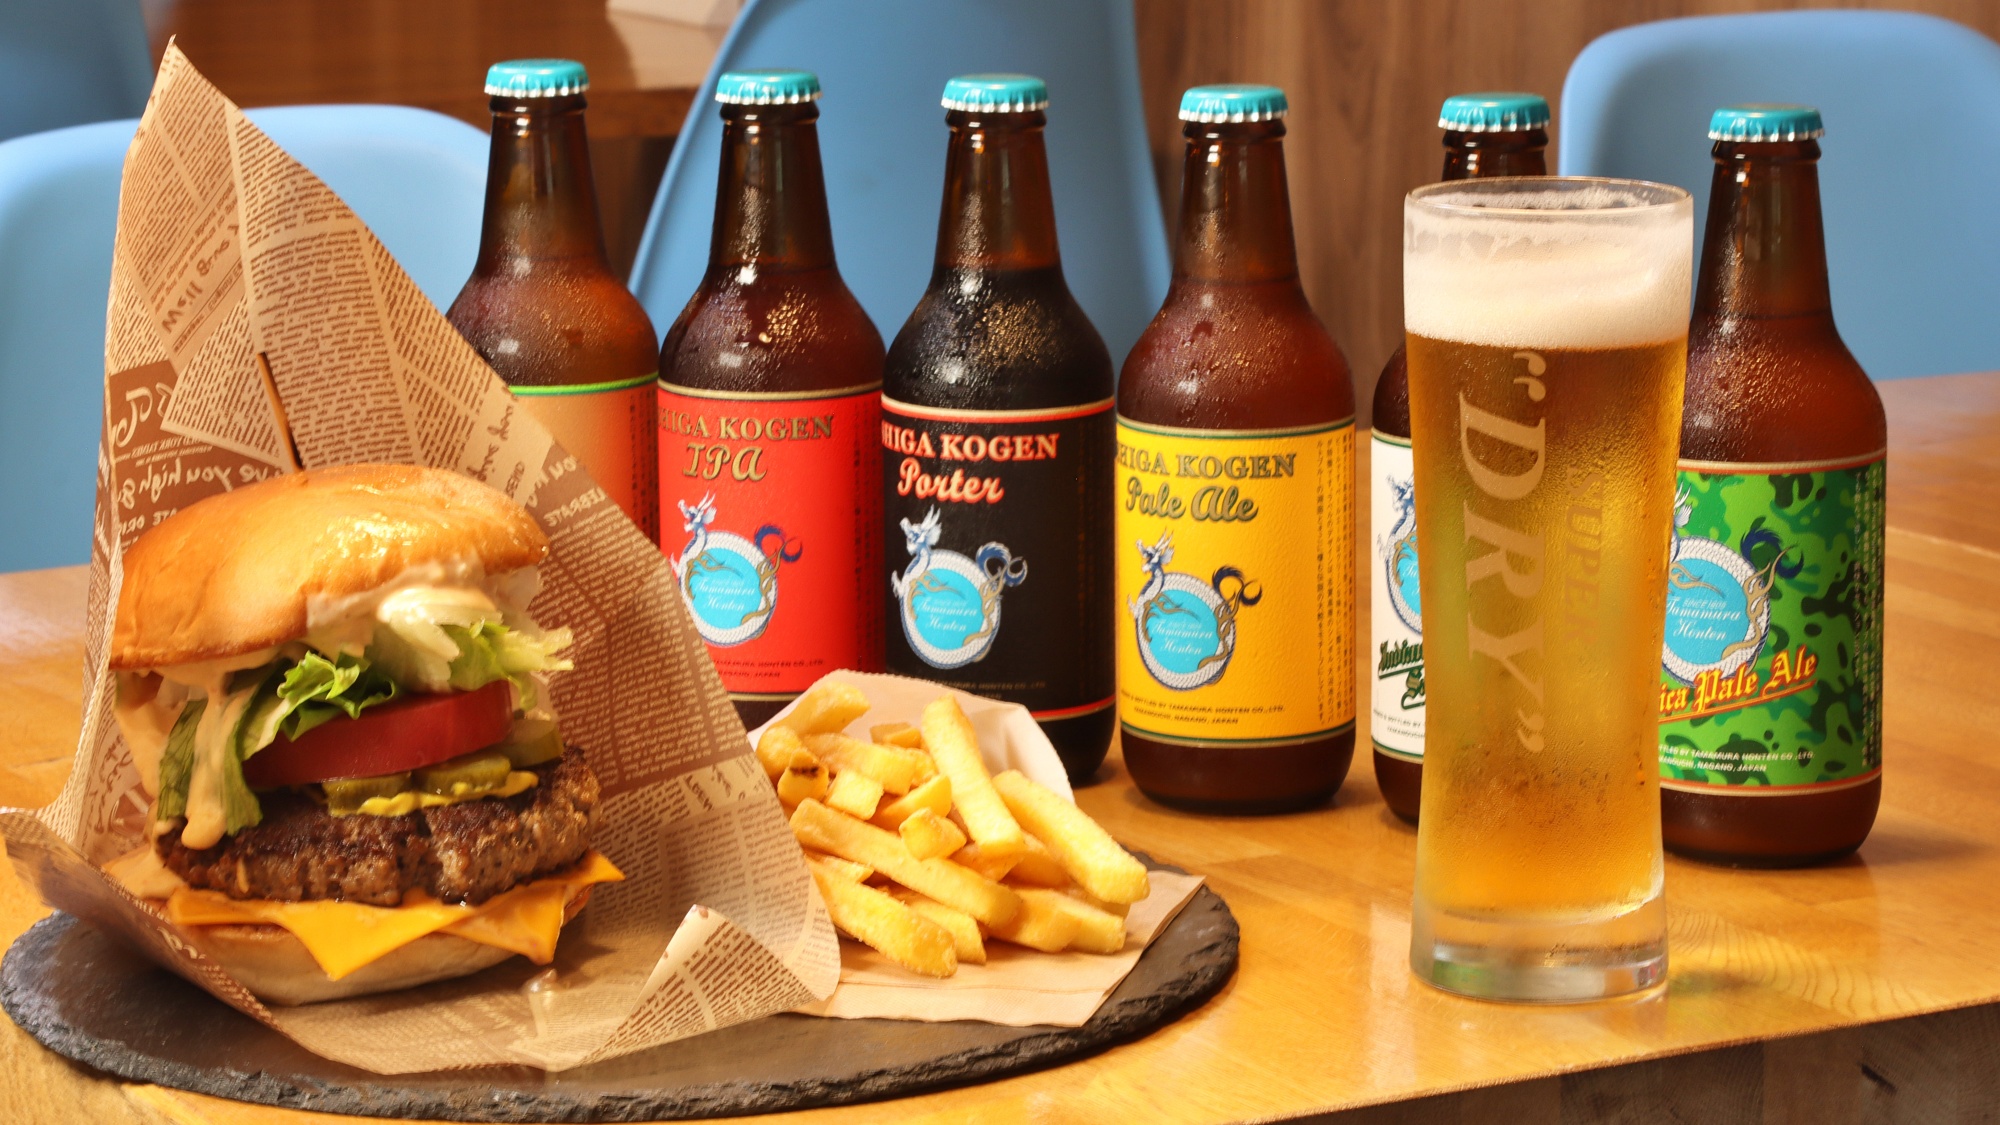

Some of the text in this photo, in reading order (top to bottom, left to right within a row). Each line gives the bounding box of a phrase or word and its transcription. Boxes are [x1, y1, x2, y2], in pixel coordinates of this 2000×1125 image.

[658, 406, 833, 441] HIGA KOGEN
[881, 419, 1060, 462] HIGA KOGEN
[682, 442, 768, 482] IPA
[897, 457, 1005, 504] Porter
[1117, 443, 1297, 479] HIGA KOGEN
[1125, 476, 1259, 522] Pale Ale
[1564, 466, 1603, 646] SUPER
[1692, 661, 1759, 713] Pale
[1761, 643, 1818, 697] Ale
[1691, 749, 1740, 761] TAMAMURA
[1741, 752, 1779, 761] HONTEN
[1736, 763, 1768, 772] JAPAN
